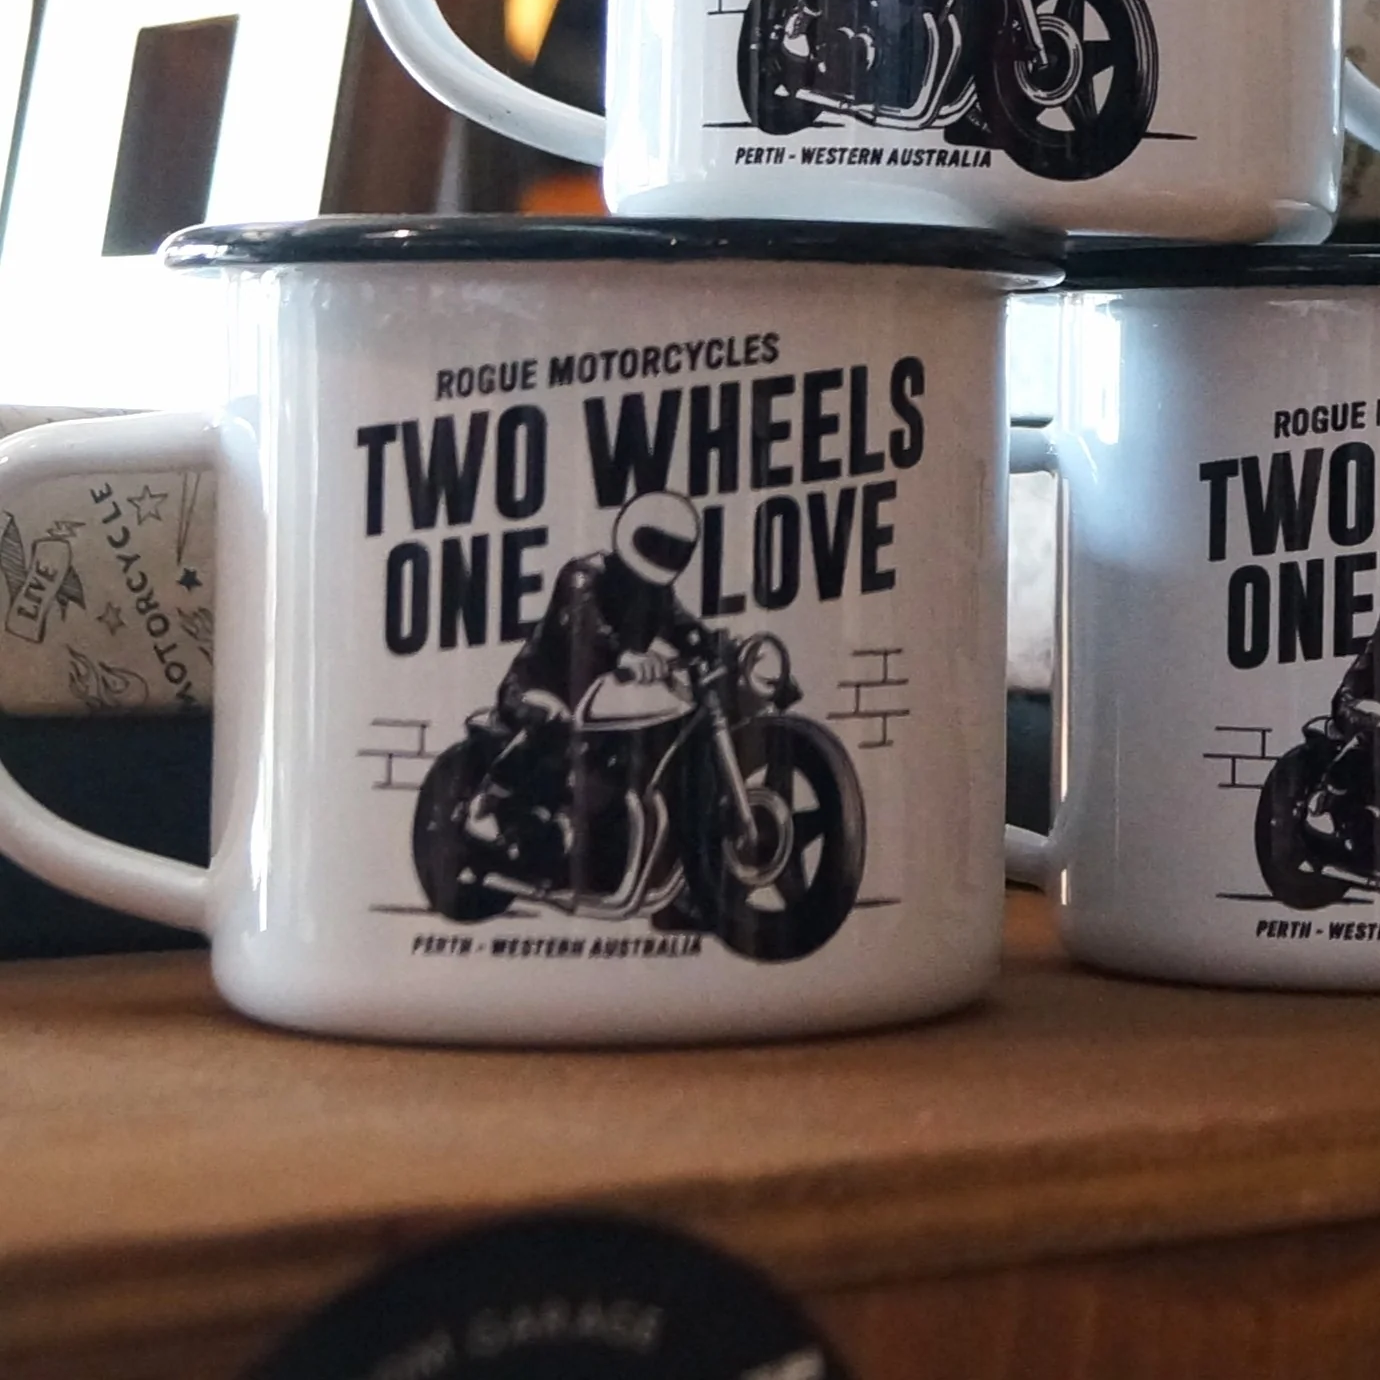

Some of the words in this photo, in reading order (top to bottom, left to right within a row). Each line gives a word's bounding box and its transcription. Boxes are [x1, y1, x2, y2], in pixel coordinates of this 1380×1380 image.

[734, 146, 786, 165] PERTH
[801, 146, 884, 166] WESTERN
[886, 148, 992, 168] AUSTRALIA
[435, 358, 538, 401] ROGUE
[548, 331, 780, 388] MOTORCYCLES
[357, 404, 547, 537] TWO
[583, 355, 925, 510] WHEELS
[1274, 401, 1366, 439] ROGUE
[1200, 441, 1375, 562] TWO
[384, 526, 549, 657] ONE
[700, 479, 897, 618] LOVE
[1227, 551, 1377, 670] ONE
[412, 934, 473, 955] PERTH
[491, 936, 586, 957] WESTERN
[588, 935, 701, 959] AUSTRALIA
[1256, 920, 1312, 938] PERTH
